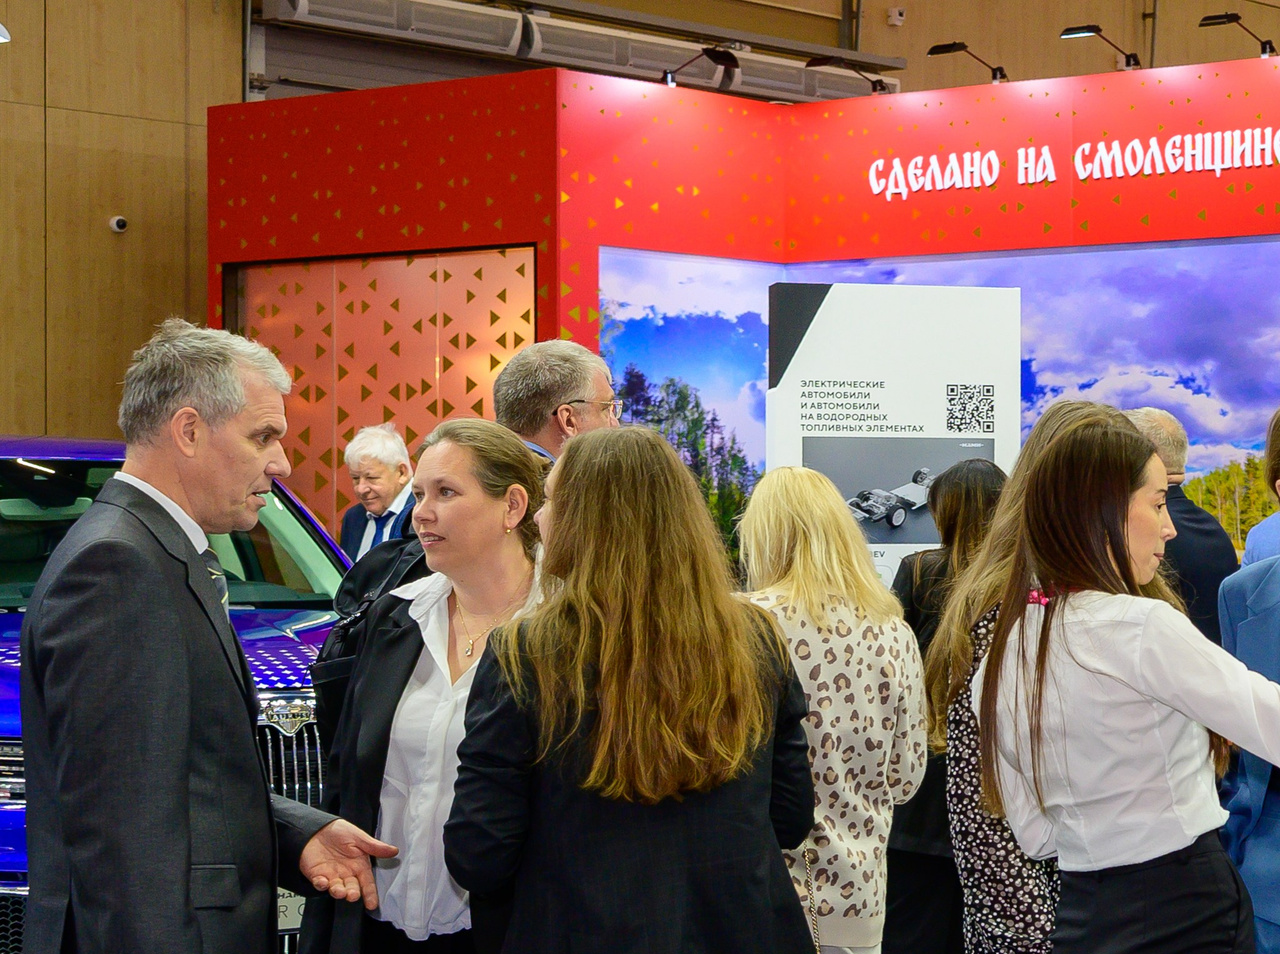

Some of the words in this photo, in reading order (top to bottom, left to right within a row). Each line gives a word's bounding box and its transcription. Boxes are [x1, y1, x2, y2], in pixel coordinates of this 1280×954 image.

[868, 149, 1000, 202] СДЕЛАНО
[1016, 145, 1056, 185] НА
[800, 380, 885, 389] ЭЛЕКТРИЧЕСКИЕ
[800, 391, 871, 399] АВТОМОБИЛИ
[800, 402, 808, 410] И
[810, 402, 880, 410] АВТОМОБИЛИ
[800, 413, 815, 421] НА
[816, 413, 888, 421] ВОДОРОДНЫХ
[800, 424, 864, 432] ТОПЛИВНЫХ
[865, 424, 925, 432] ЭЛЕМЕНТАХ
